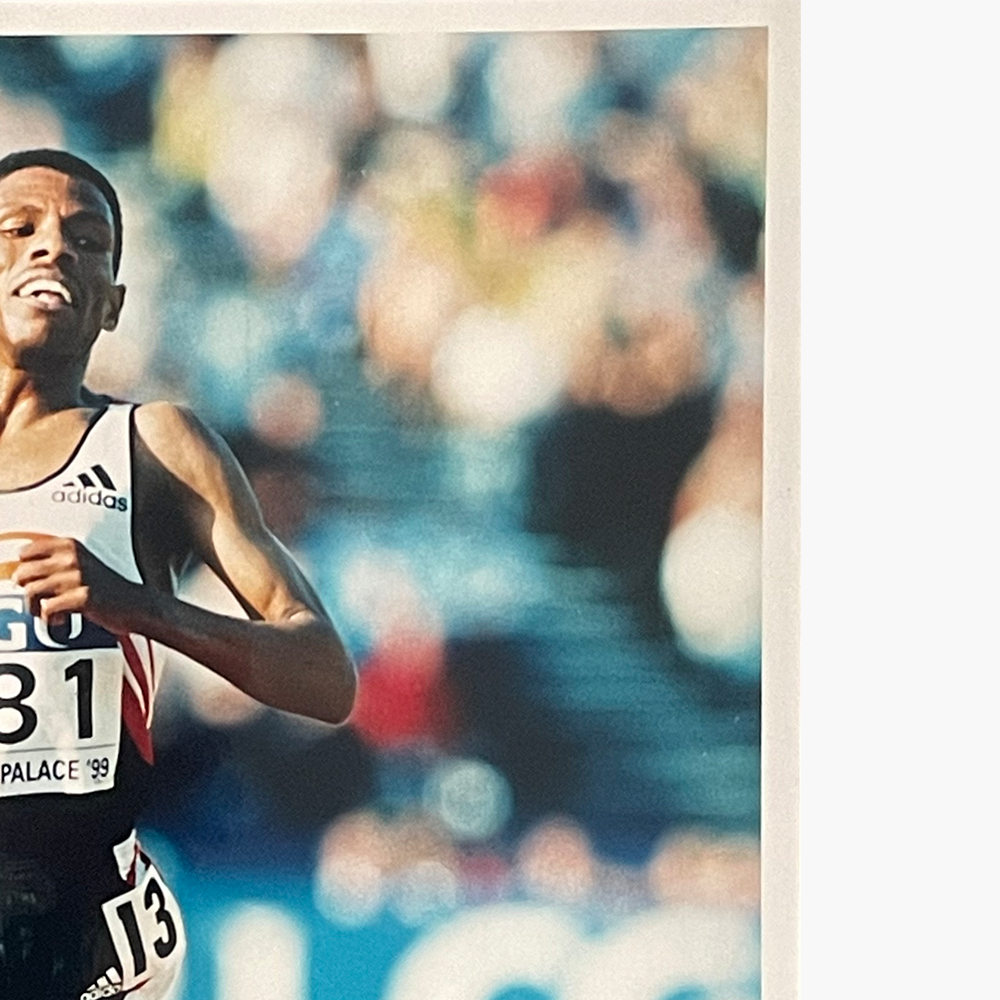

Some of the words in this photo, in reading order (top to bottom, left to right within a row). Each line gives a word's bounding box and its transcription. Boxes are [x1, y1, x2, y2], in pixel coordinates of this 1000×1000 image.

[51, 488, 128, 512] adidas
[0, 760, 80, 784] PALACE
[116, 876, 177, 978] 13
